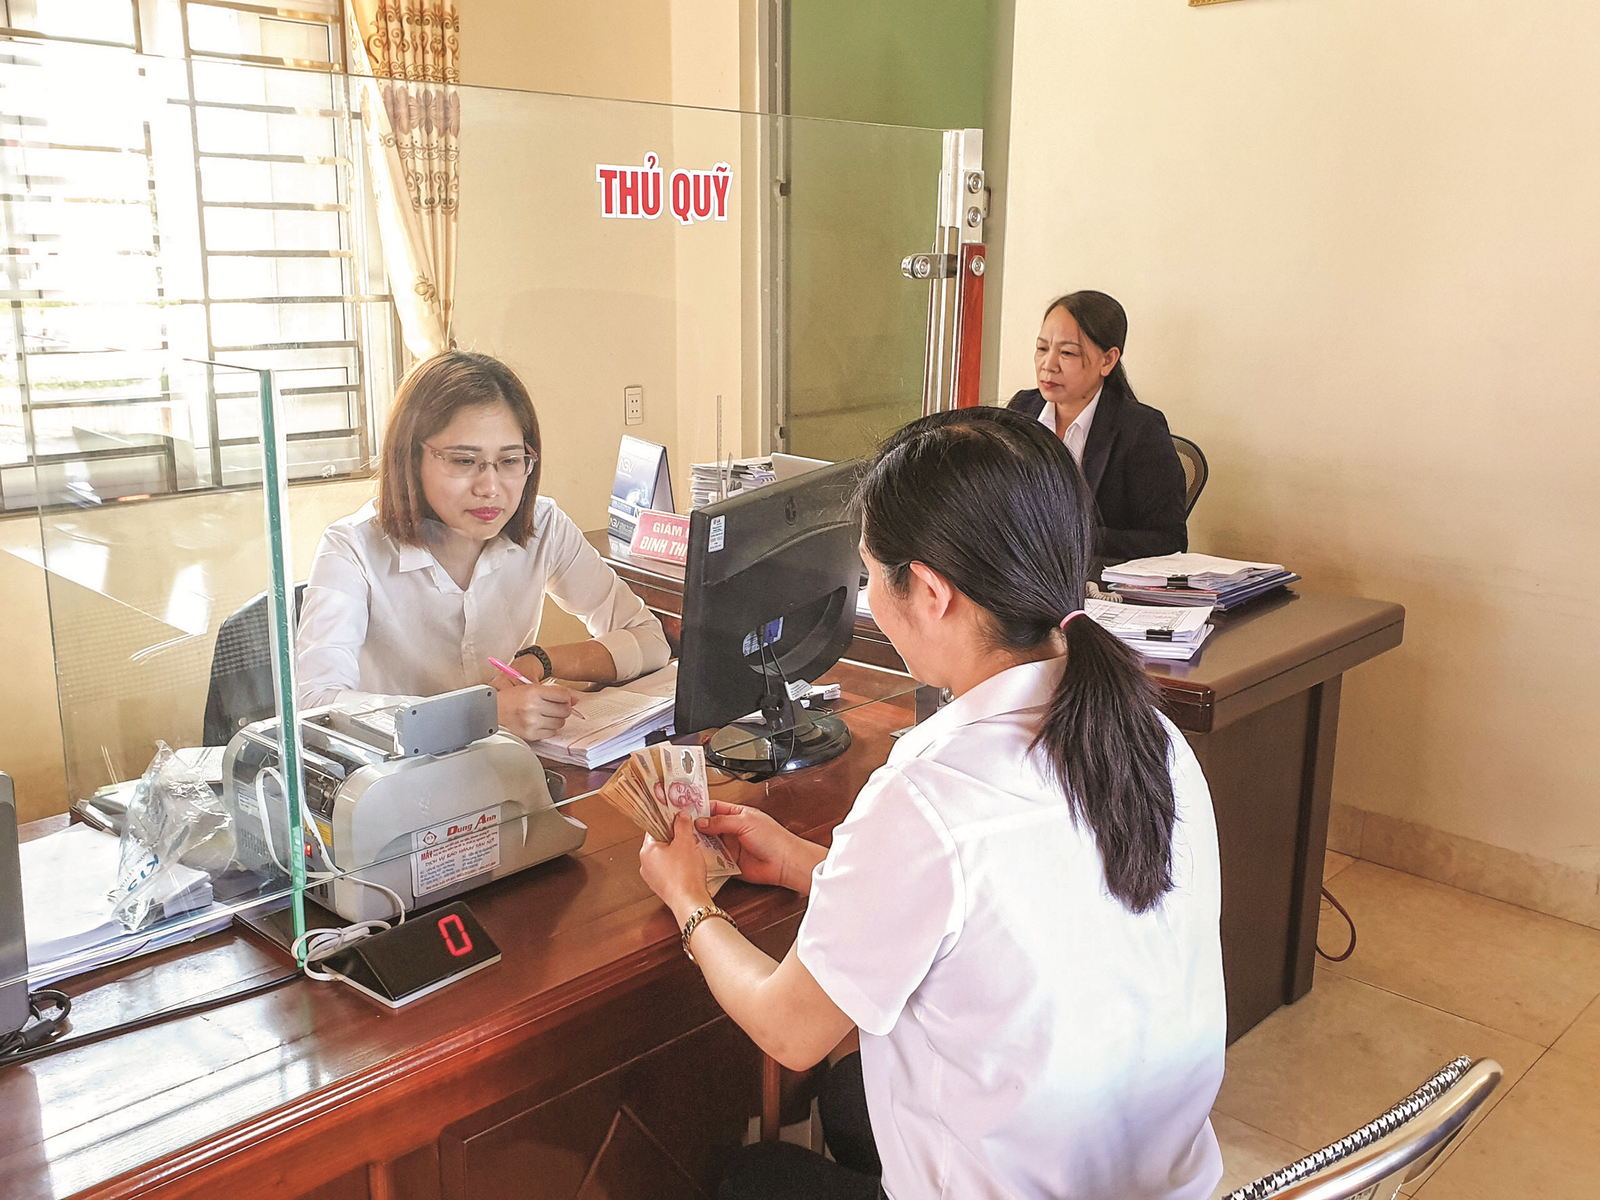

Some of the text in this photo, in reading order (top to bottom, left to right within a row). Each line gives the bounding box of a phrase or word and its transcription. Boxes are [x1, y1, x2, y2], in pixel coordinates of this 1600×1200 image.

[599, 154, 730, 222] THỦ QUỸ
[652, 521, 684, 537] GIÁM
[437, 913, 474, 957] 0
